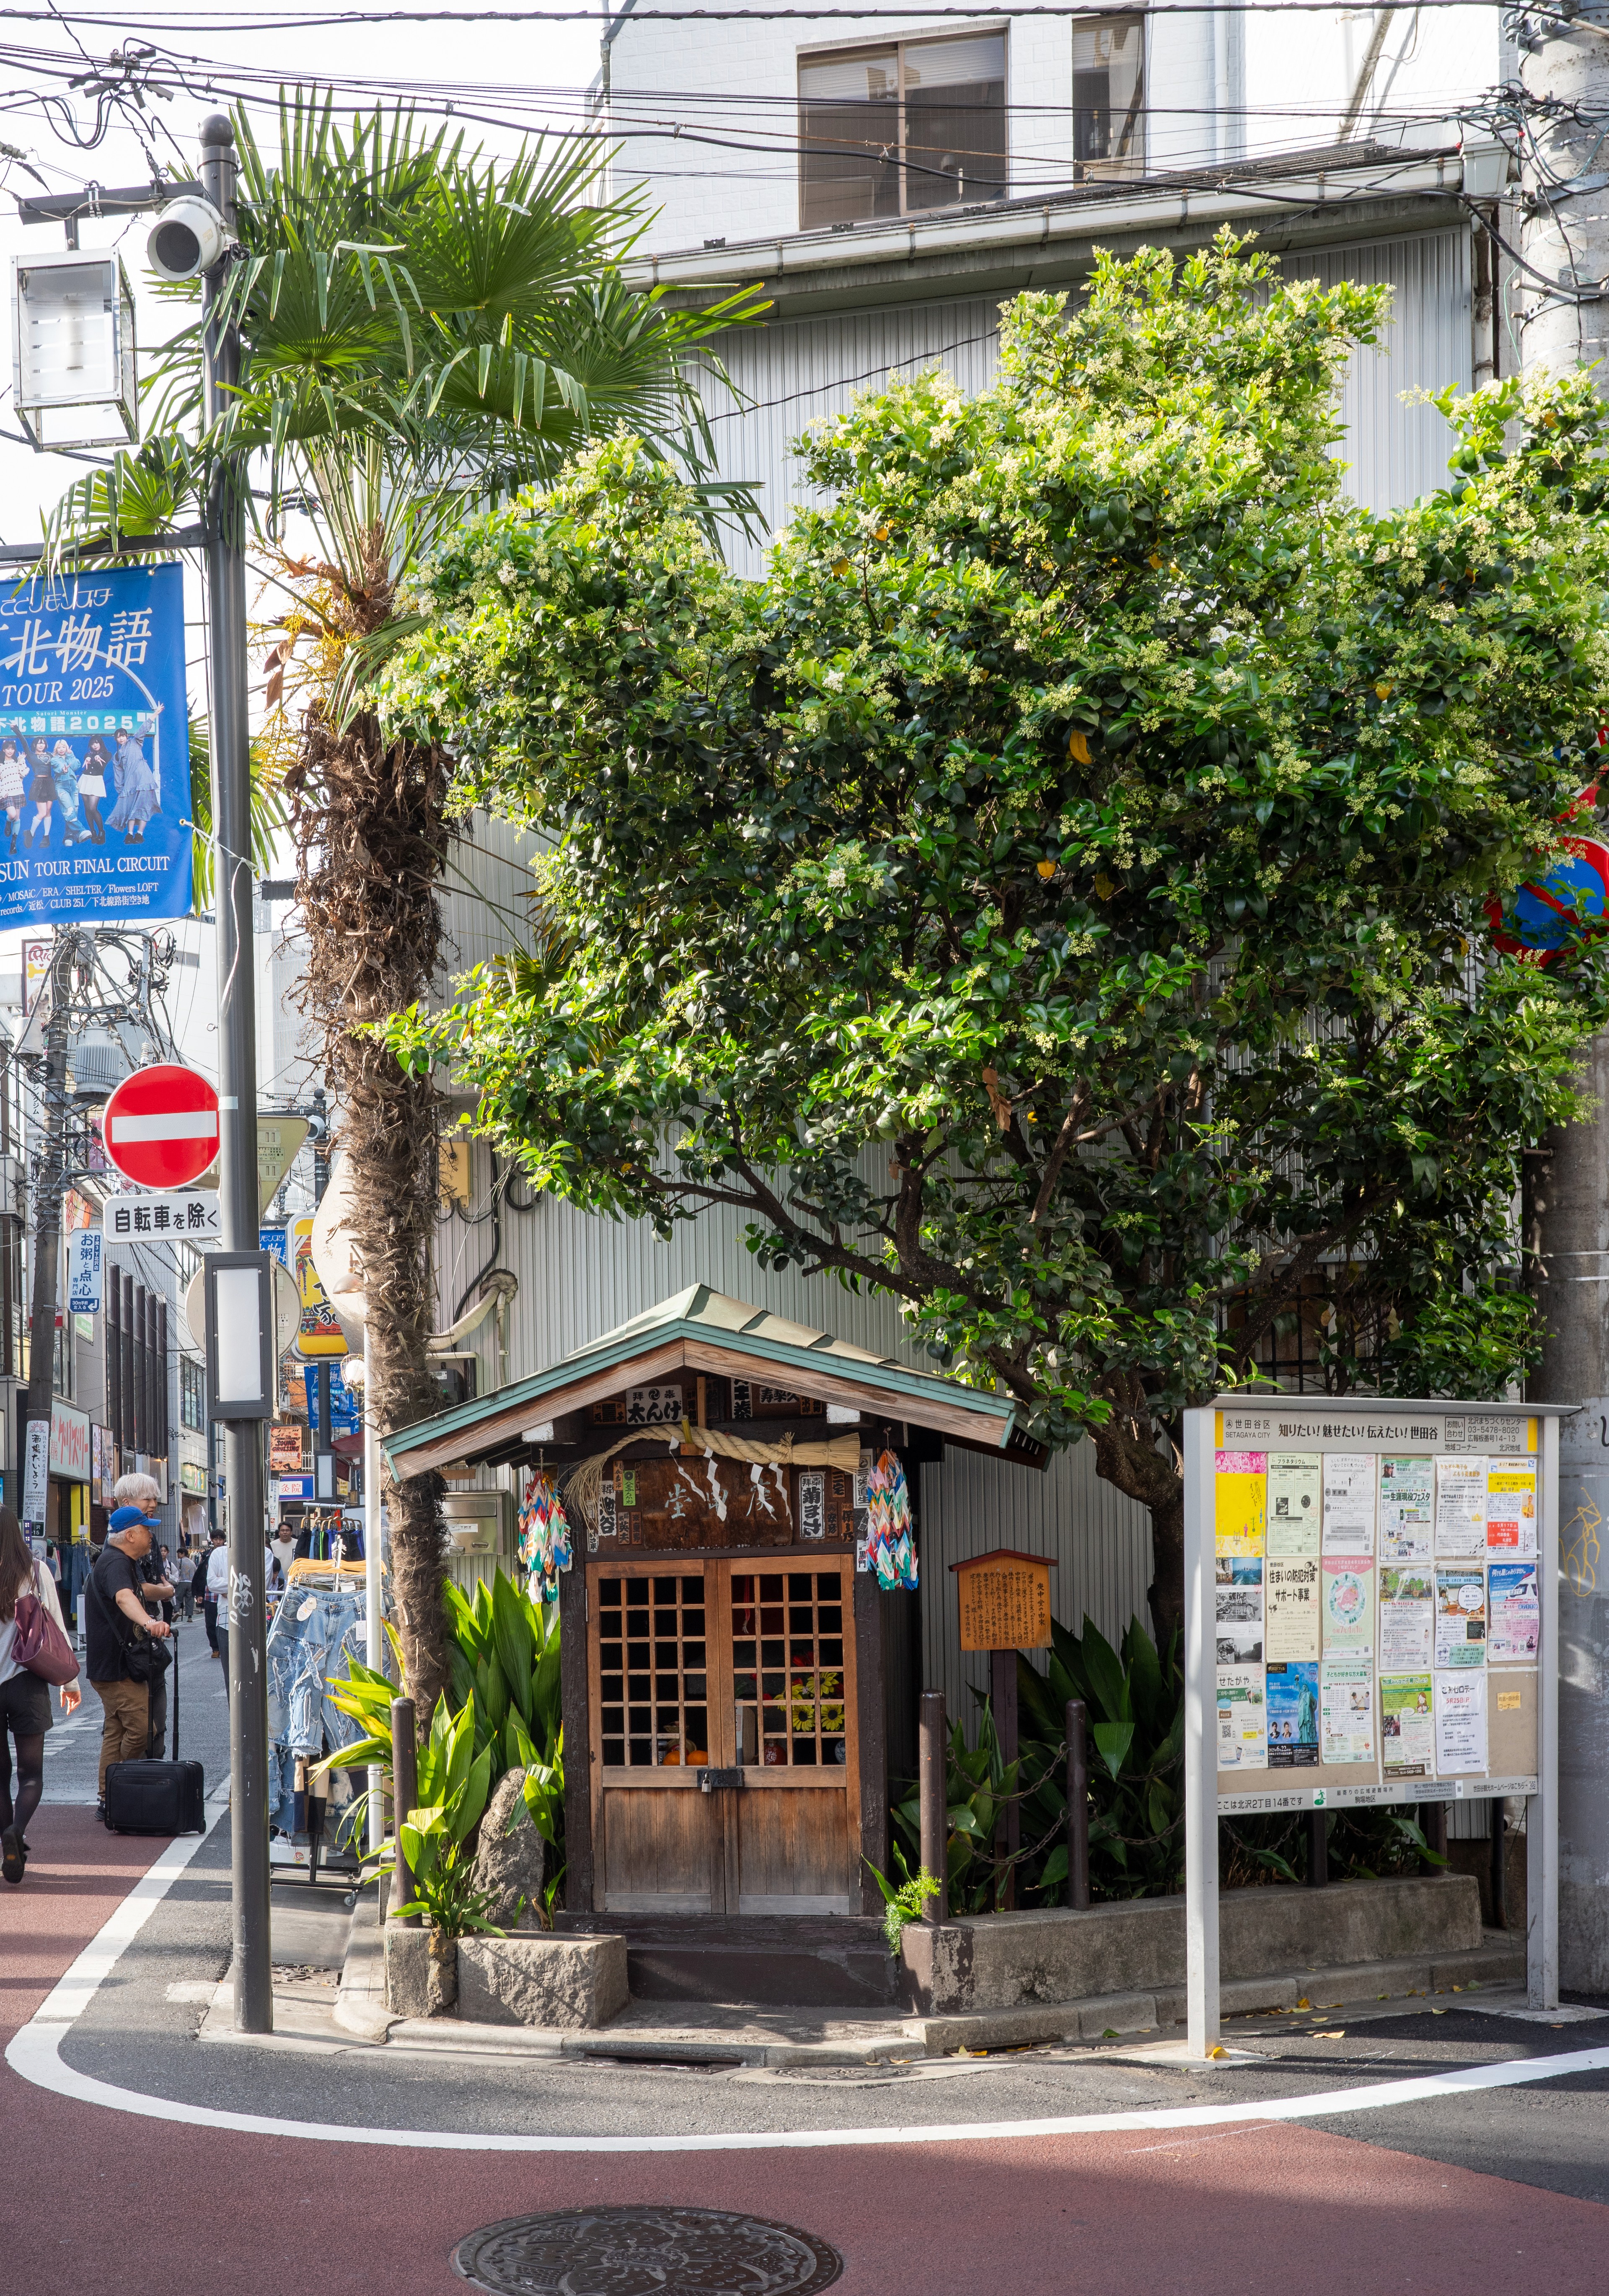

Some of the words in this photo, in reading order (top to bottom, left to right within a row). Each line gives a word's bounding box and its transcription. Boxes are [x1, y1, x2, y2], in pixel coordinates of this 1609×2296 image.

[0, 607, 153, 678] 北物語
[2, 681, 63, 707] TOUR
[70, 676, 114, 701] 2025
[34, 861, 70, 877] TOUR
[74, 858, 114, 874] FINAL
[117, 856, 170, 871] CIRCUIT
[137, 882, 159, 892] LOFT
[115, 1202, 217, 1233] 自転車を除く
[79, 1233, 93, 1296] お粥と点心
[1235, 1419, 1270, 1429] 世田谷区
[1468, 1416, 1526, 1426] 北沢まちづくりセンター
[1445, 1443, 1477, 1451] 地域コーナー
[31, 1434, 41, 1489] 酒場たいよう
[281, 1483, 301, 1494] 灸院
[1390, 1492, 1430, 1501] 生涯現役フェスタ
[1269, 1569, 1315, 1584] 住まいの防犯対策
[1275, 1588, 1310, 1602] サポート事業
[1218, 1676, 1250, 1686] せたがや
[1382, 1677, 1428, 1685] 地域みんなで子育てしよう
[1473, 1782, 1524, 1793] 世田谷観光ホームページはこちら
[1217, 1796, 1304, 1809] ここは北沢2丁目14番です
